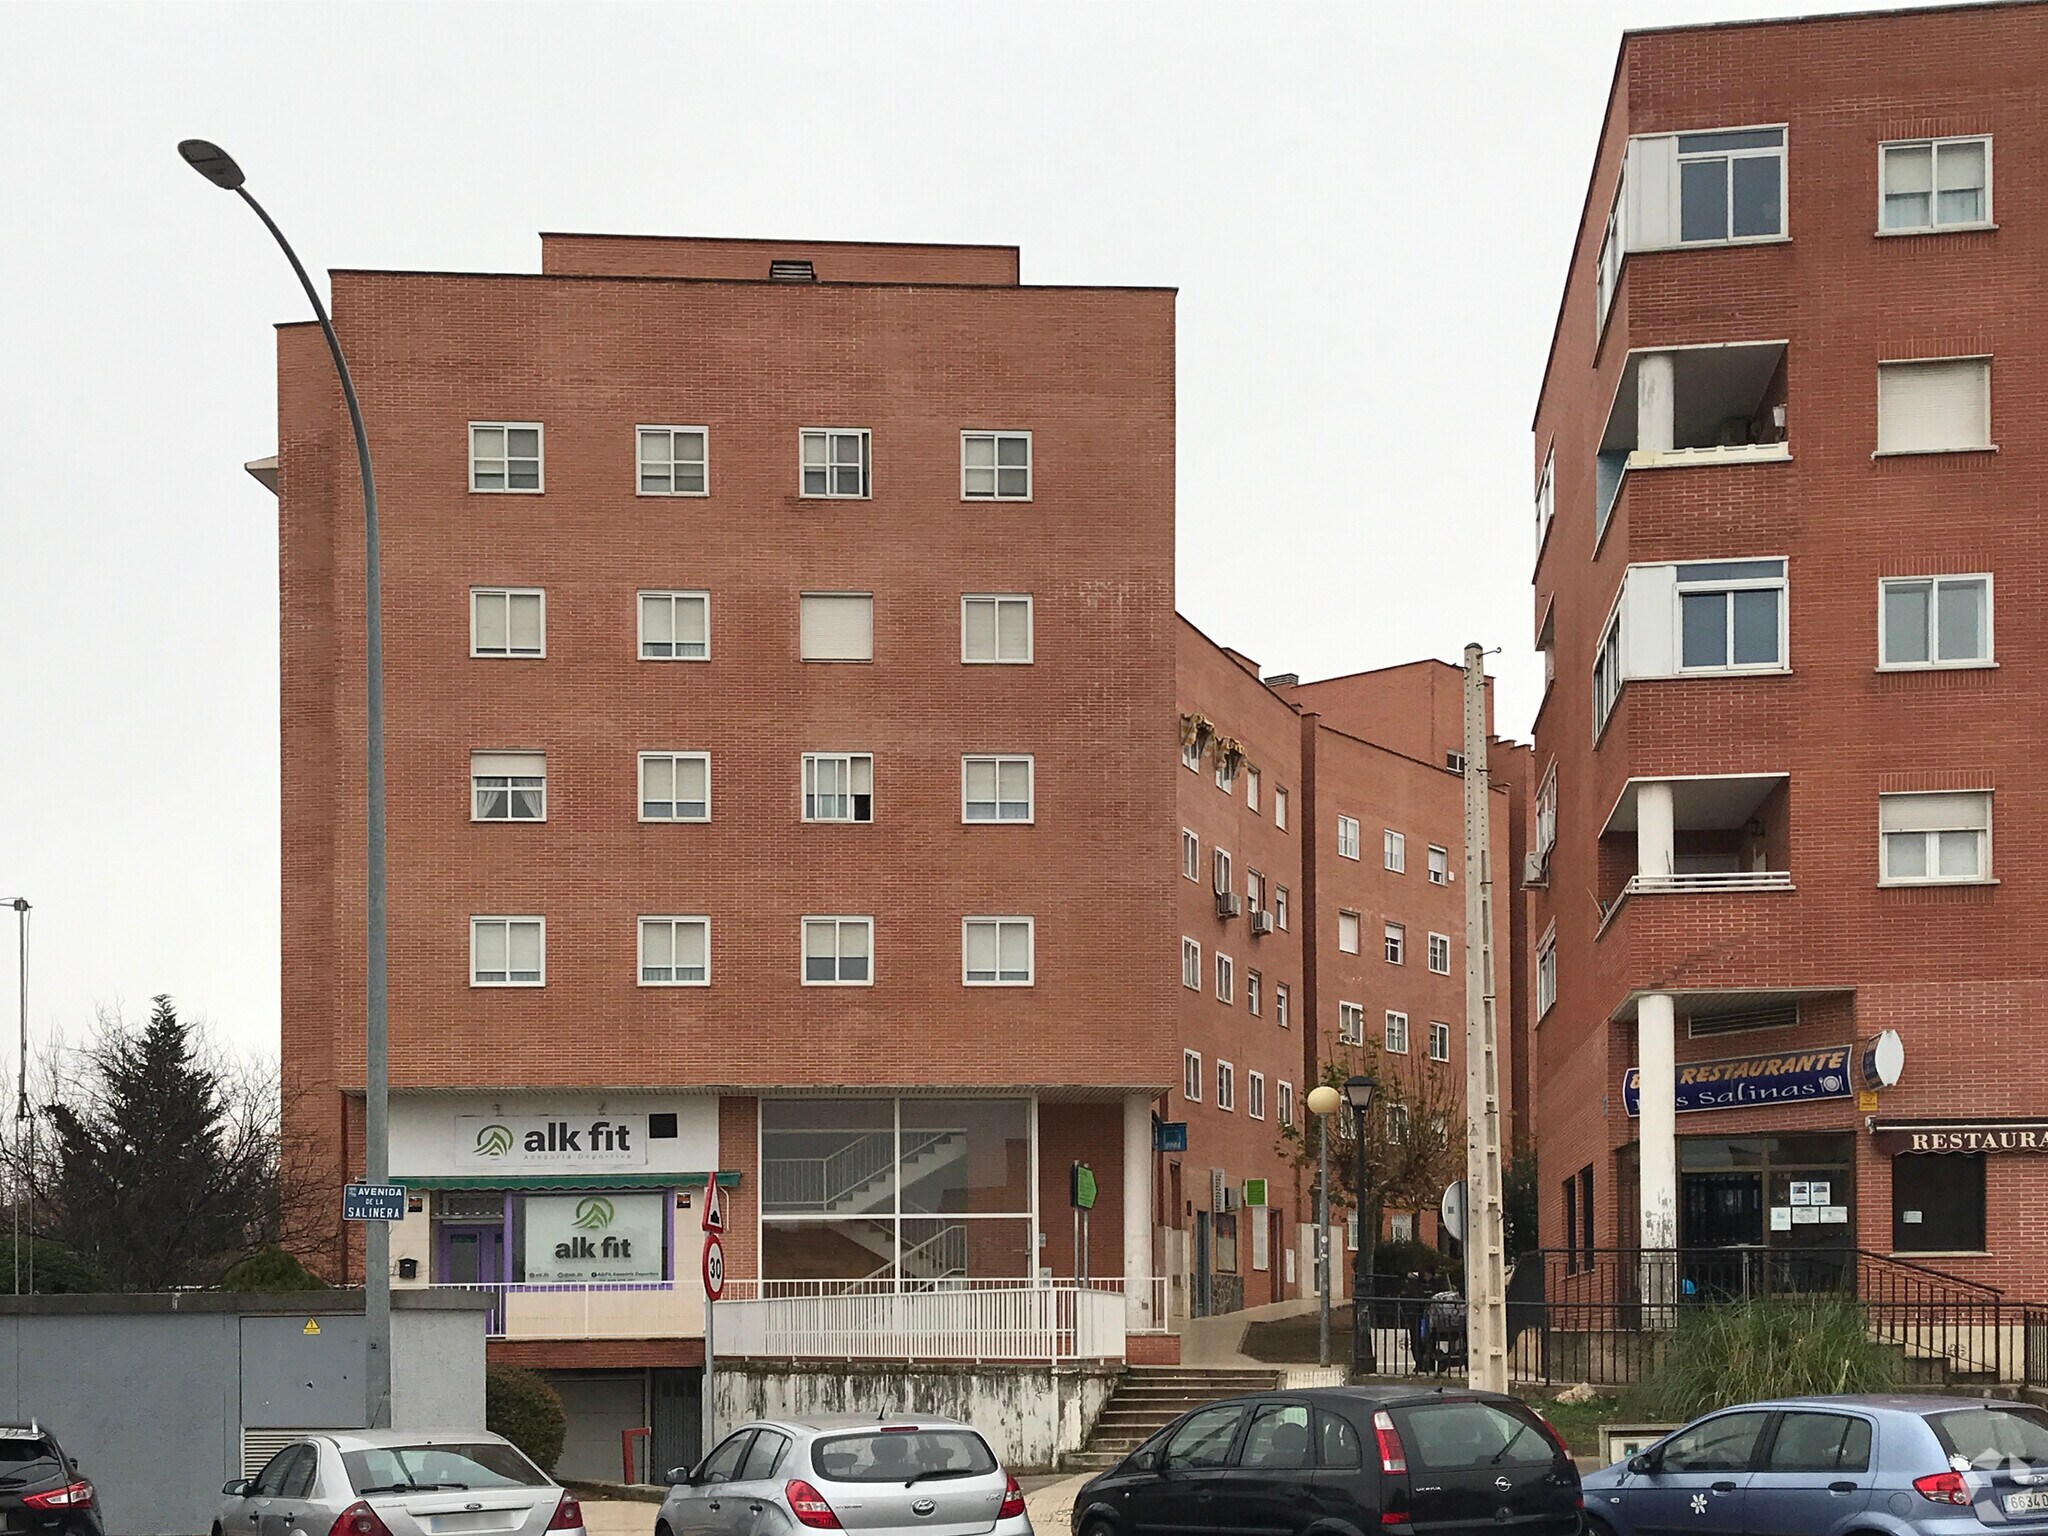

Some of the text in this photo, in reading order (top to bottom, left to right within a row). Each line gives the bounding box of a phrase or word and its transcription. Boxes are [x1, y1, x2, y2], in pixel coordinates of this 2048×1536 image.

[1680, 1052, 1846, 1084] RESTAURANTE
[1698, 1082, 1816, 1105] Salinas
[523, 1121, 631, 1152] alk fit
[358, 1187, 402, 1197] AVENIDA
[347, 1206, 400, 1219] SALINERA
[554, 1236, 631, 1259] alk fit
[709, 1257, 721, 1279] 30
[2011, 1495, 2040, 1508] 6634
